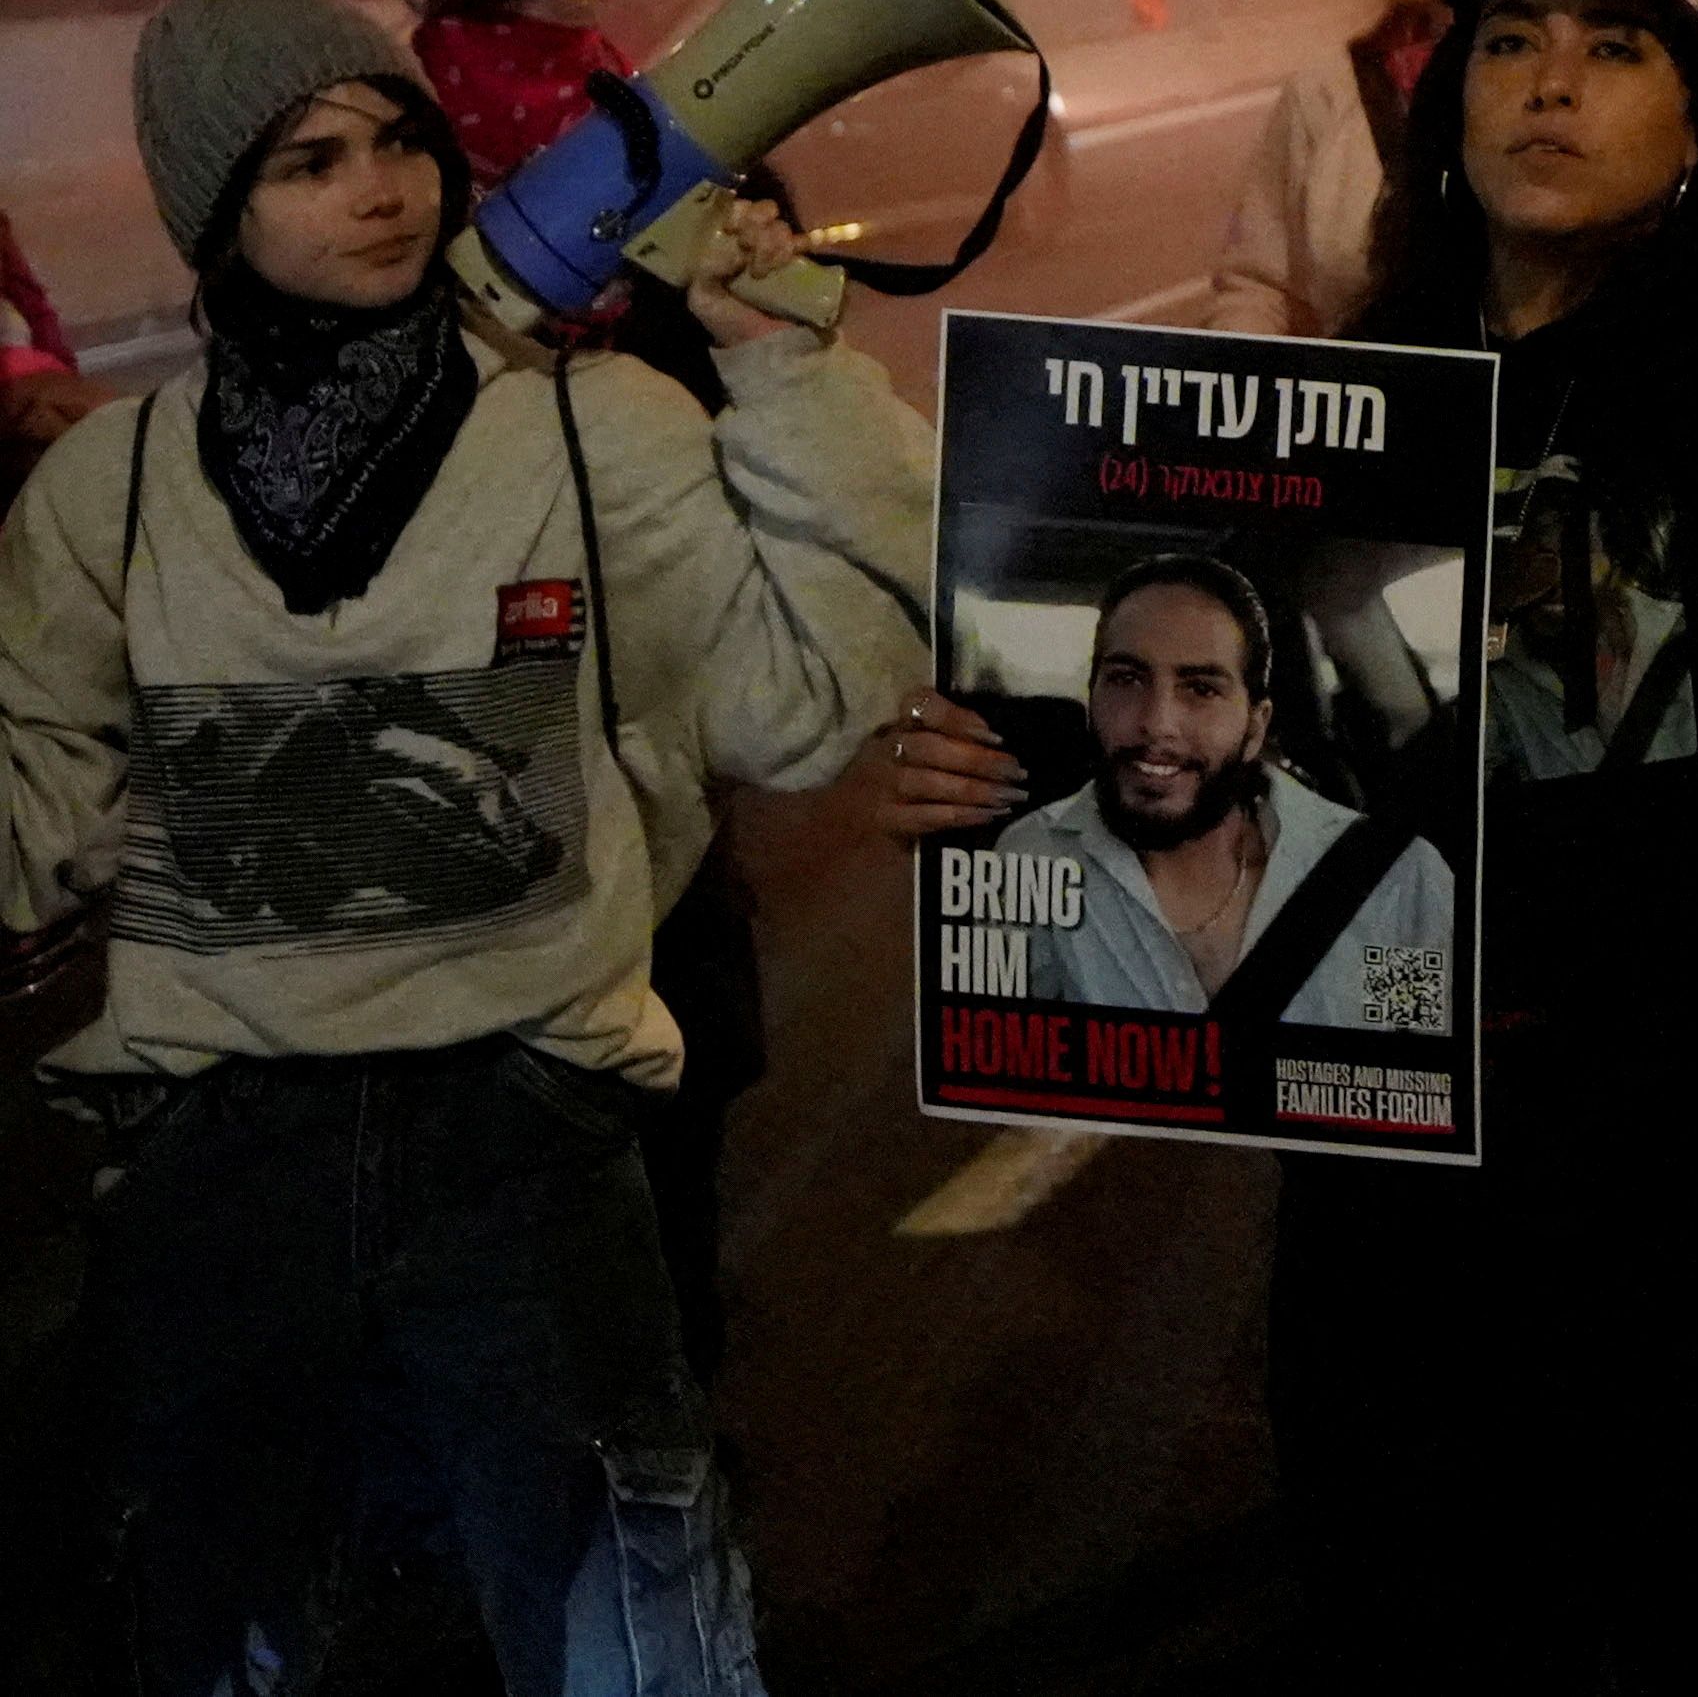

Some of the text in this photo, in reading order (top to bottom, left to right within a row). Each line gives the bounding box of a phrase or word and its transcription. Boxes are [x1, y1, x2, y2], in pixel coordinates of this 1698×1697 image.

[1045, 357, 1386, 458] מתן עדיין חי
[1099, 453, 1149, 499] (24)
[1271, 473, 1324, 509] מתן
[941, 847, 1084, 929] BRING
[940, 924, 1029, 999] HIM
[941, 1006, 1221, 1097] HOME NOW!
[1276, 1057, 1453, 1095] HOSTAGES AND MISSING
[1276, 1080, 1453, 1127] FAMILIES FORUM
